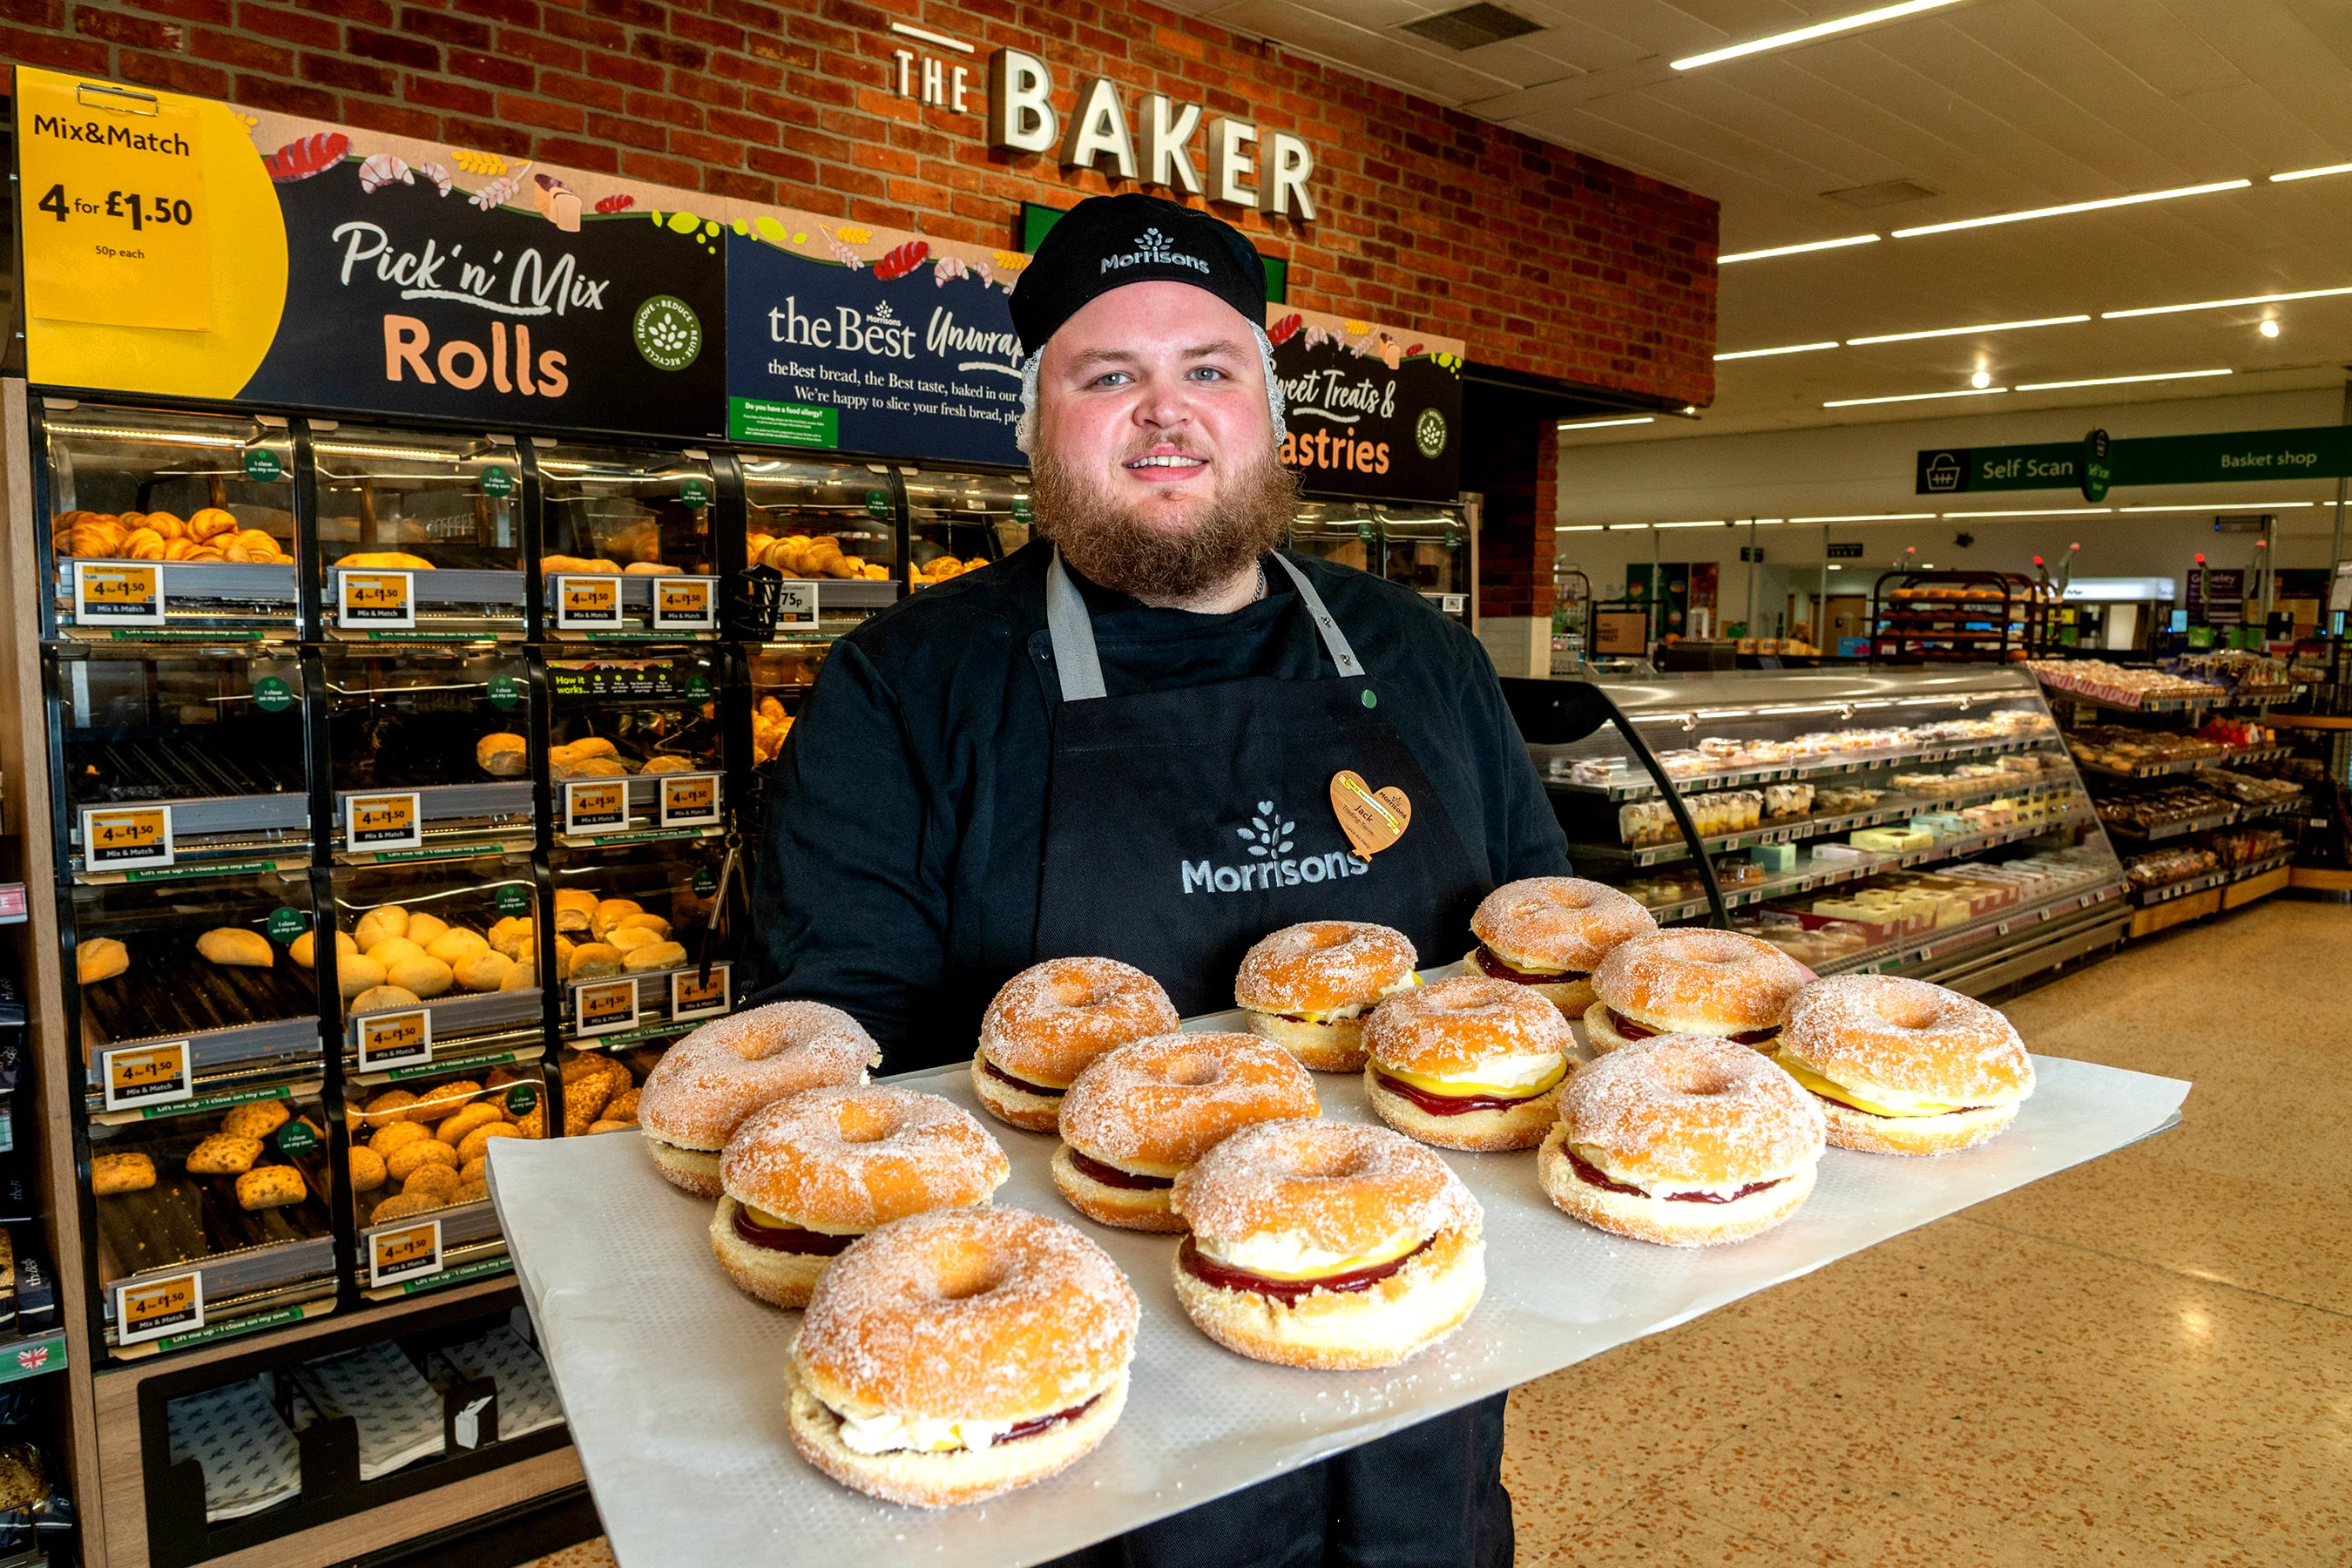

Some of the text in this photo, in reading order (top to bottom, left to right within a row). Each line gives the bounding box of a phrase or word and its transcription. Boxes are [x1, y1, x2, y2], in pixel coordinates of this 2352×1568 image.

[34, 114, 190, 156] Mix&Match
[896, 46, 1316, 221] THE BAKER
[38, 183, 193, 231] 4 for £1.50
[95, 245, 145, 260] 50p each
[1100, 250, 1210, 274] Morrisons
[661, 300, 693, 322] REDUCE
[866, 314, 902, 327] Morrisons
[638, 303, 655, 339] REMOVE
[685, 330, 698, 358] REUSE
[926, 306, 1024, 368] Unwrap
[383, 314, 570, 398] Rolls
[645, 346, 680, 366] RECYCLE
[820, 364, 861, 386] bread,
[865, 371, 884, 387] the
[889, 373, 914, 389] Best
[918, 380, 948, 396] taste,
[951, 382, 983, 398] baked
[986, 387, 996, 399] in
[998, 392, 1017, 402] our
[1322, 369, 1380, 414] Treats
[1380, 380, 1396, 419] &
[767, 404, 781, 413] have
[801, 409, 822, 418] allergy?
[794, 385, 1021, 425] We're happy to slice your fresh bread, ple
[1280, 428, 1389, 475] astries
[2221, 449, 2317, 468] Basket shop
[1983, 458, 2022, 479] Self
[2026, 458, 2073, 476] Scan
[94, 582, 105, 595] 4
[118, 583, 145, 596] £1.50
[355, 589, 398, 601] 4 £1.50
[571, 592, 579, 605] 4
[666, 594, 673, 605] 4
[781, 592, 802, 607] 75p
[579, 799, 586, 809] 4
[673, 793, 680, 803] 4
[1379, 792, 1407, 819] Morrisons
[362, 813, 371, 824] 4
[382, 810, 404, 823] £1.50
[1342, 804, 1361, 823] Trading
[1355, 805, 1373, 822] Jack
[104, 828, 113, 841] 4
[126, 826, 153, 839] £1.50
[1181, 850, 1369, 894] Morrisons
[590, 1000, 597, 1010] 4
[374, 1032, 382, 1044] 4
[123, 1067, 133, 1079] 4
[145, 1061, 172, 1076] £1.50
[150, 1083, 172, 1092] Match
[385, 1247, 394, 1258] 4
[136, 1301, 145, 1313] 4
[158, 1293, 184, 1308] £1.50
[162, 1314, 185, 1323] Match
